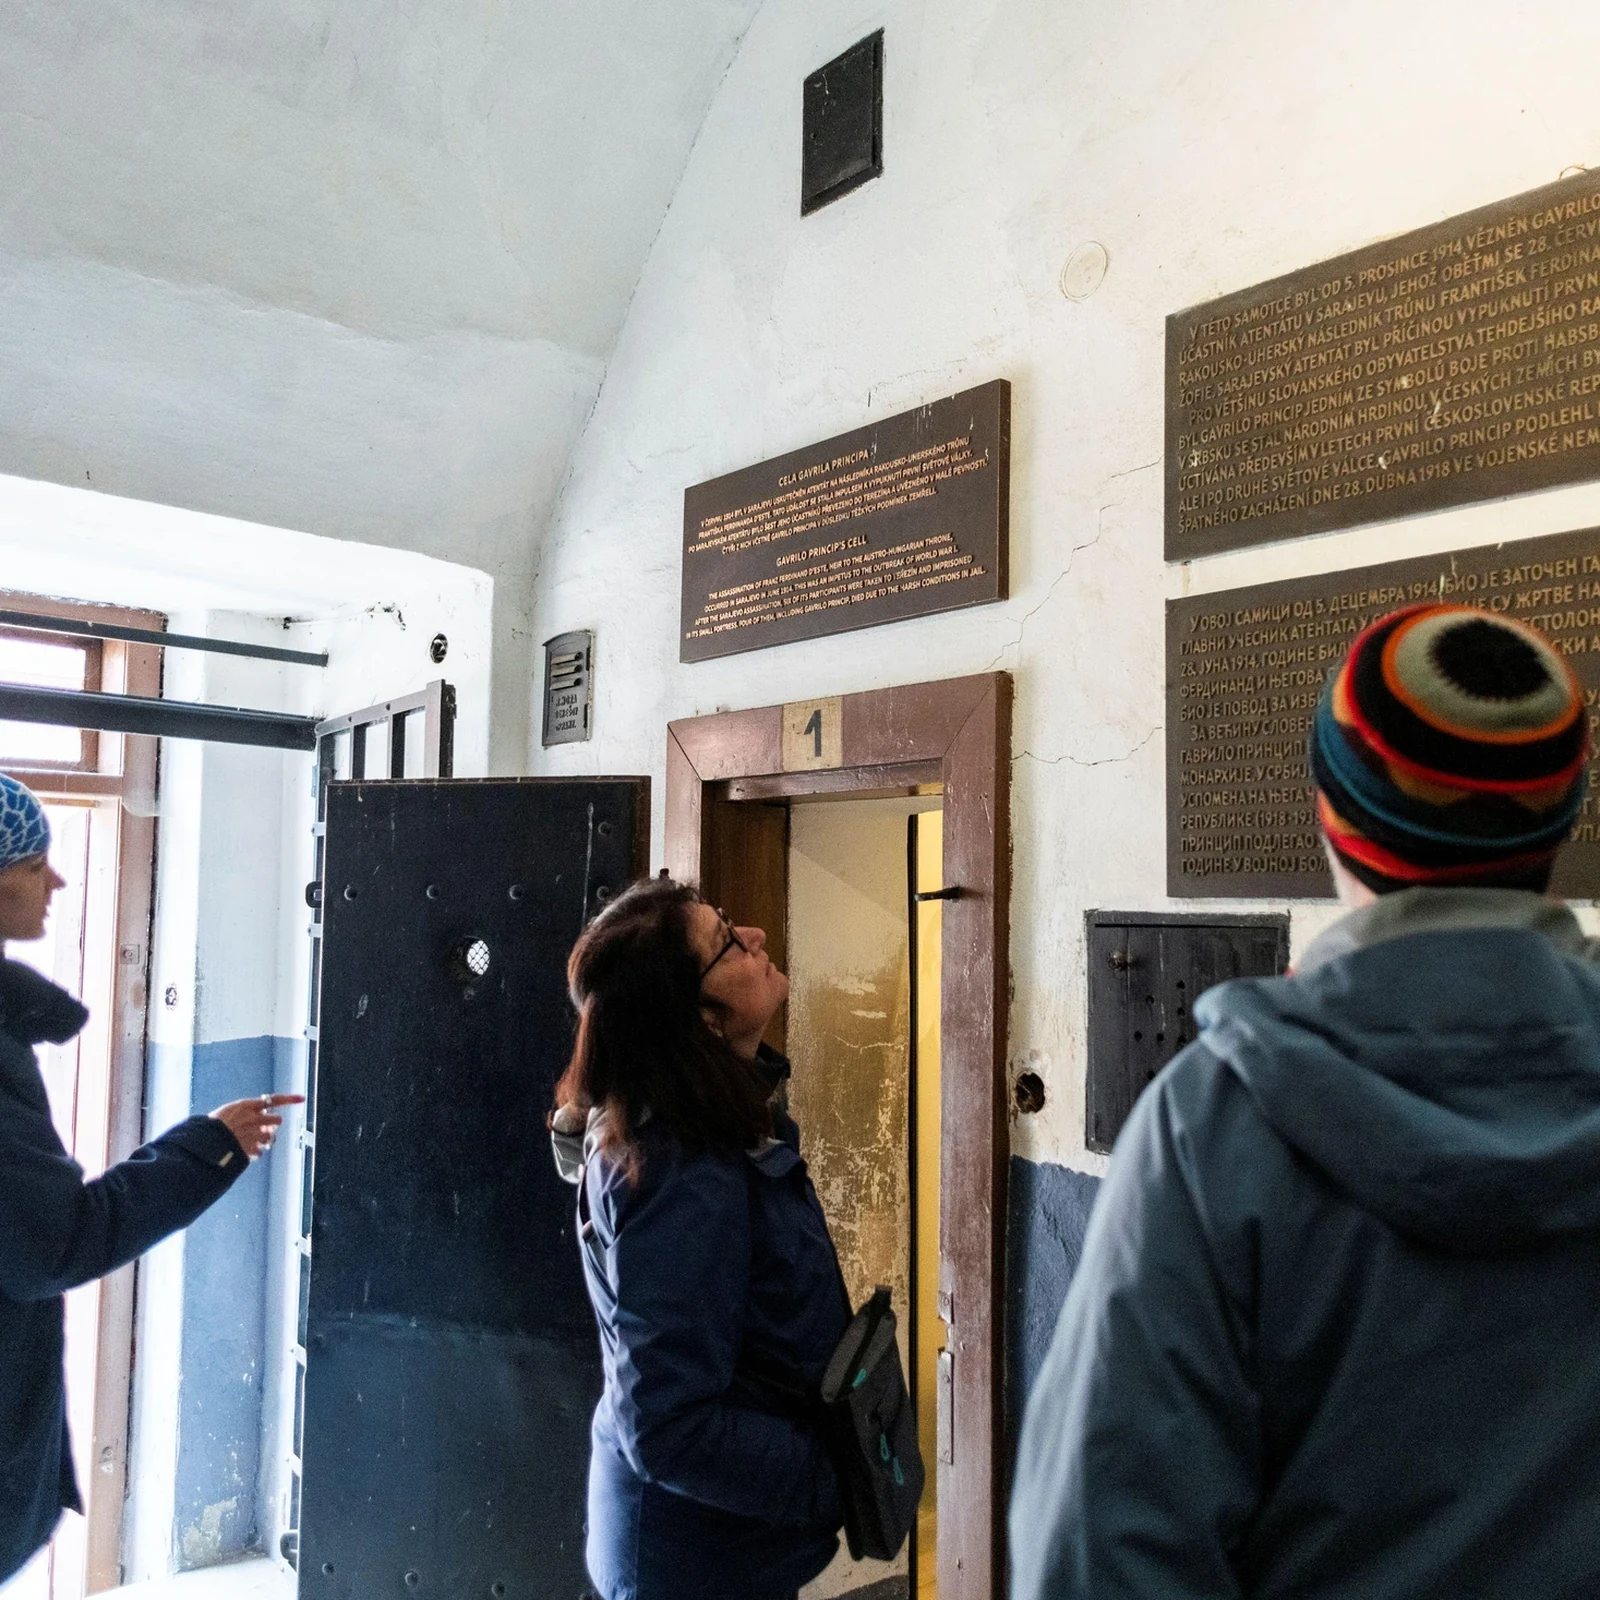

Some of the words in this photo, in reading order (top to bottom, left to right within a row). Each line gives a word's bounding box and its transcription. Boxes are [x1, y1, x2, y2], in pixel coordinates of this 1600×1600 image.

[1189, 326, 1197, 342] V
[1201, 315, 1231, 338] TÉTO
[1234, 295, 1291, 327] SAMOTCE
[1295, 286, 1318, 307] BYL
[1322, 279, 1339, 299] OD
[1344, 273, 1355, 291] 5.
[1359, 249, 1428, 286] PROSINCE
[1466, 214, 1527, 252] VĚZNĚN
[1532, 192, 1600, 230] GAVRILO
[1179, 332, 1236, 365] ÚČASTNÍK
[1240, 313, 1301, 346] ATENTÁTU
[1316, 285, 1387, 322] SARAJEVU,
[1390, 265, 1436, 299] JEHOŽ
[1442, 250, 1499, 283] OBĚŤMI
[1504, 242, 1523, 263] SE
[1528, 233, 1551, 256] 28.
[1556, 217, 1600, 247] ČERV
[1179, 330, 1304, 386] RAKOUSKO-UHERSKÝ
[1308, 308, 1381, 347] NÁSLEDNÍK
[1384, 294, 1435, 324] TRŮNU
[1441, 266, 1527, 307] FRANTIŠEK
[1217, 356, 1292, 396] SARAJEVSKÝ
[1294, 341, 1351, 374] ATENTÁT
[1354, 335, 1378, 356] BYL
[1383, 313, 1453, 348] PŘÍČINOU
[1457, 279, 1549, 327] VYPUKNUTÍ
[1189, 406, 1212, 425] PRO
[1215, 390, 1265, 418] VĚTŠINU
[1269, 363, 1361, 403] SLOVANSKÉHO
[1366, 331, 1474, 376] OBYVATELSTVA
[1476, 302, 1575, 345] TEHDEJŠÍHO
[1179, 431, 1198, 449] BYL
[1200, 417, 1250, 443] GAVRILO
[1254, 402, 1302, 429] PRINCIP
[1304, 386, 1353, 416] JEDNÍM
[1356, 383, 1372, 402] ZE
[1377, 359, 1443, 397] SYMBOLŮ
[1449, 352, 1488, 377] BOJE
[1492, 338, 1538, 366] PROTI
[1188, 443, 1230, 468] SRBSKU
[1235, 438, 1250, 456] SE
[1252, 431, 1280, 452] STAL
[1284, 409, 1354, 444] NÁRODNÍM
[1358, 392, 1427, 425] HRDINOU,
[1442, 371, 1510, 403] ČESKÝCH
[1517, 354, 1576, 385] ZEMÍCH
[1179, 463, 1235, 491] UCTÍVÁNA
[1239, 443, 1307, 477] PŘEDEVŠÍM
[1321, 430, 1370, 457] LETECH
[1376, 414, 1418, 444] PRVNÍ
[1424, 378, 1564, 432] ČESKOSLOVENSKÉ
[778, 472, 796, 487] CELA
[798, 461, 829, 481] GAVRILA
[831, 448, 868, 470] PRINCIPA
[1179, 494, 1199, 512] ALE
[1207, 488, 1222, 505] PO
[1226, 473, 1268, 501] DRUHÉ
[1272, 459, 1329, 491] SVĚTOVÉ
[1383, 437, 1443, 466] GAVRILO
[1450, 421, 1510, 450] PRINCIP
[1516, 402, 1593, 435] PODLEHL
[1179, 506, 1237, 533] ŠPATNÉHO
[1241, 486, 1310, 520] ZACHÁZENÍ
[1313, 484, 1339, 505] DNE
[1344, 479, 1362, 498] 28.
[1366, 467, 1416, 493] DUBNA
[1420, 460, 1450, 482] 1918
[1453, 455, 1473, 475] VE
[1477, 431, 1557, 469] VOJENSKÉ
[776, 550, 806, 567] GAVRILO
[808, 540, 845, 558] PRINCIP'S
[847, 534, 866, 548] CELL
[863, 539, 924, 561] AUSTRO-HUNGARIAN
[873, 557, 904, 572] OUTBREAK
[906, 555, 913, 564] OF
[915, 549, 937, 562] WORLD
[938, 546, 952, 556] WAR
[922, 571, 960, 587] CONDITIONS
[1201, 612, 1230, 630] ОВОЈ
[1235, 603, 1289, 625] САМИЦИ
[1294, 600, 1312, 618] ОД
[1328, 585, 1404, 615] ДЕЦЕМБРА
[1445, 574, 1476, 594] БИО
[1481, 570, 1498, 588] ЈЕ
[1502, 558, 1576, 585] ЗАТОЧЕН
[1180, 635, 1224, 655] ГЛАВНИ
[1228, 626, 1287, 648] УЧЕСНИК
[1290, 616, 1356, 639] АТЕНТАТА
[1517, 585, 1573, 608] ЖРТВЕ
[1199, 656, 1228, 674] ЈУНА
[1262, 645, 1314, 667] ГОДИНЕ
[1180, 676, 1253, 698] ФЕРДИНАНД
[1269, 668, 1323, 688] ЊЕГОВА
[1180, 704, 1204, 720] БИО
[1207, 702, 1219, 717] ЈЕ
[1223, 697, 1267, 716] ПОВОД
[1271, 695, 1288, 711] ЗА
[804, 709, 821, 757] 1
[1208, 721, 1259, 739] ВЕЋИНУ
[1180, 745, 1234, 763] ГАВРИЛО
[1237, 740, 1302, 760] ПРИНЦИП
[1180, 790, 1246, 807] УСПОМЕНА
[1250, 789, 1265, 804] НА
[1181, 813, 1250, 829] РЕПУБЛИКЕ
[1181, 836, 1241, 853] ПРИНЦИП
[1244, 834, 1314, 853] ПОДЛЕГАО
[1181, 857, 1230, 874] ГОДИНЕ
